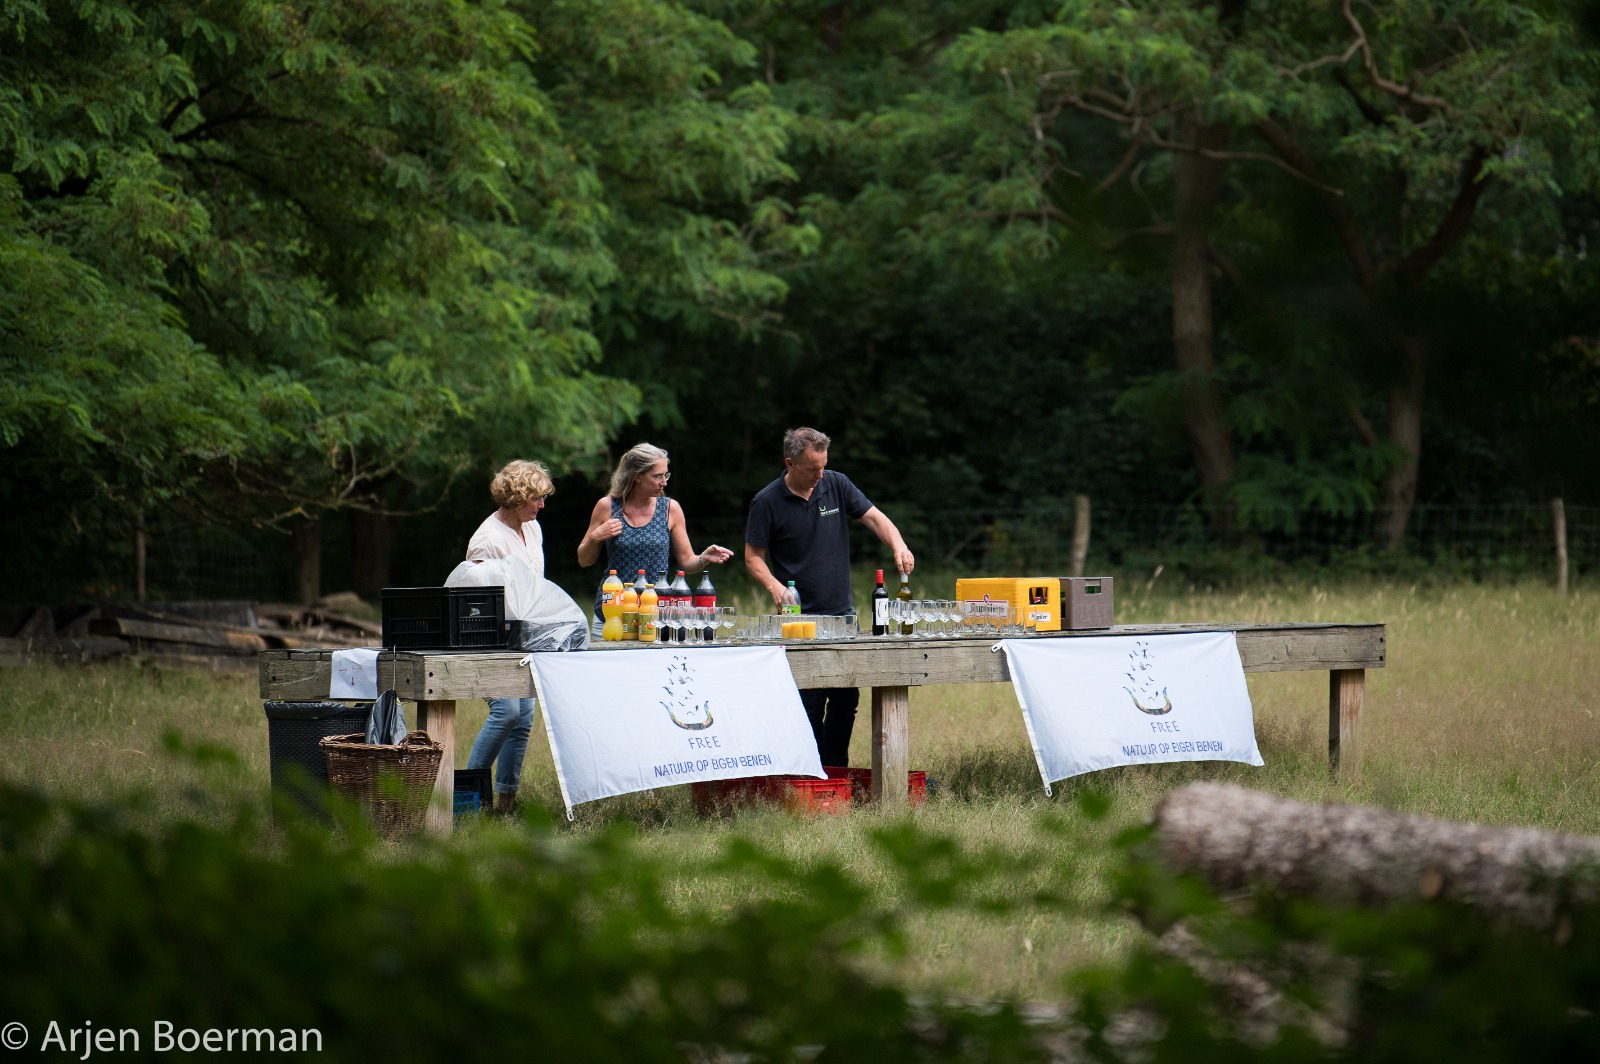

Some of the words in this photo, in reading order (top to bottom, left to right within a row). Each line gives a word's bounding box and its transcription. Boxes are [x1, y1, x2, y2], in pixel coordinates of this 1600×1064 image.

[1150, 721, 1180, 733] FREE
[688, 735, 721, 749] FREE
[1122, 743, 1158, 757] NATUUR
[1158, 742, 1170, 754] OP
[1172, 741, 1195, 753] EIGEN
[1196, 741, 1223, 752] BENEN
[654, 761, 695, 777] NATUUR
[696, 759, 709, 772] OP
[711, 757, 738, 770] EIGEN
[739, 754, 772, 767] BENEN
